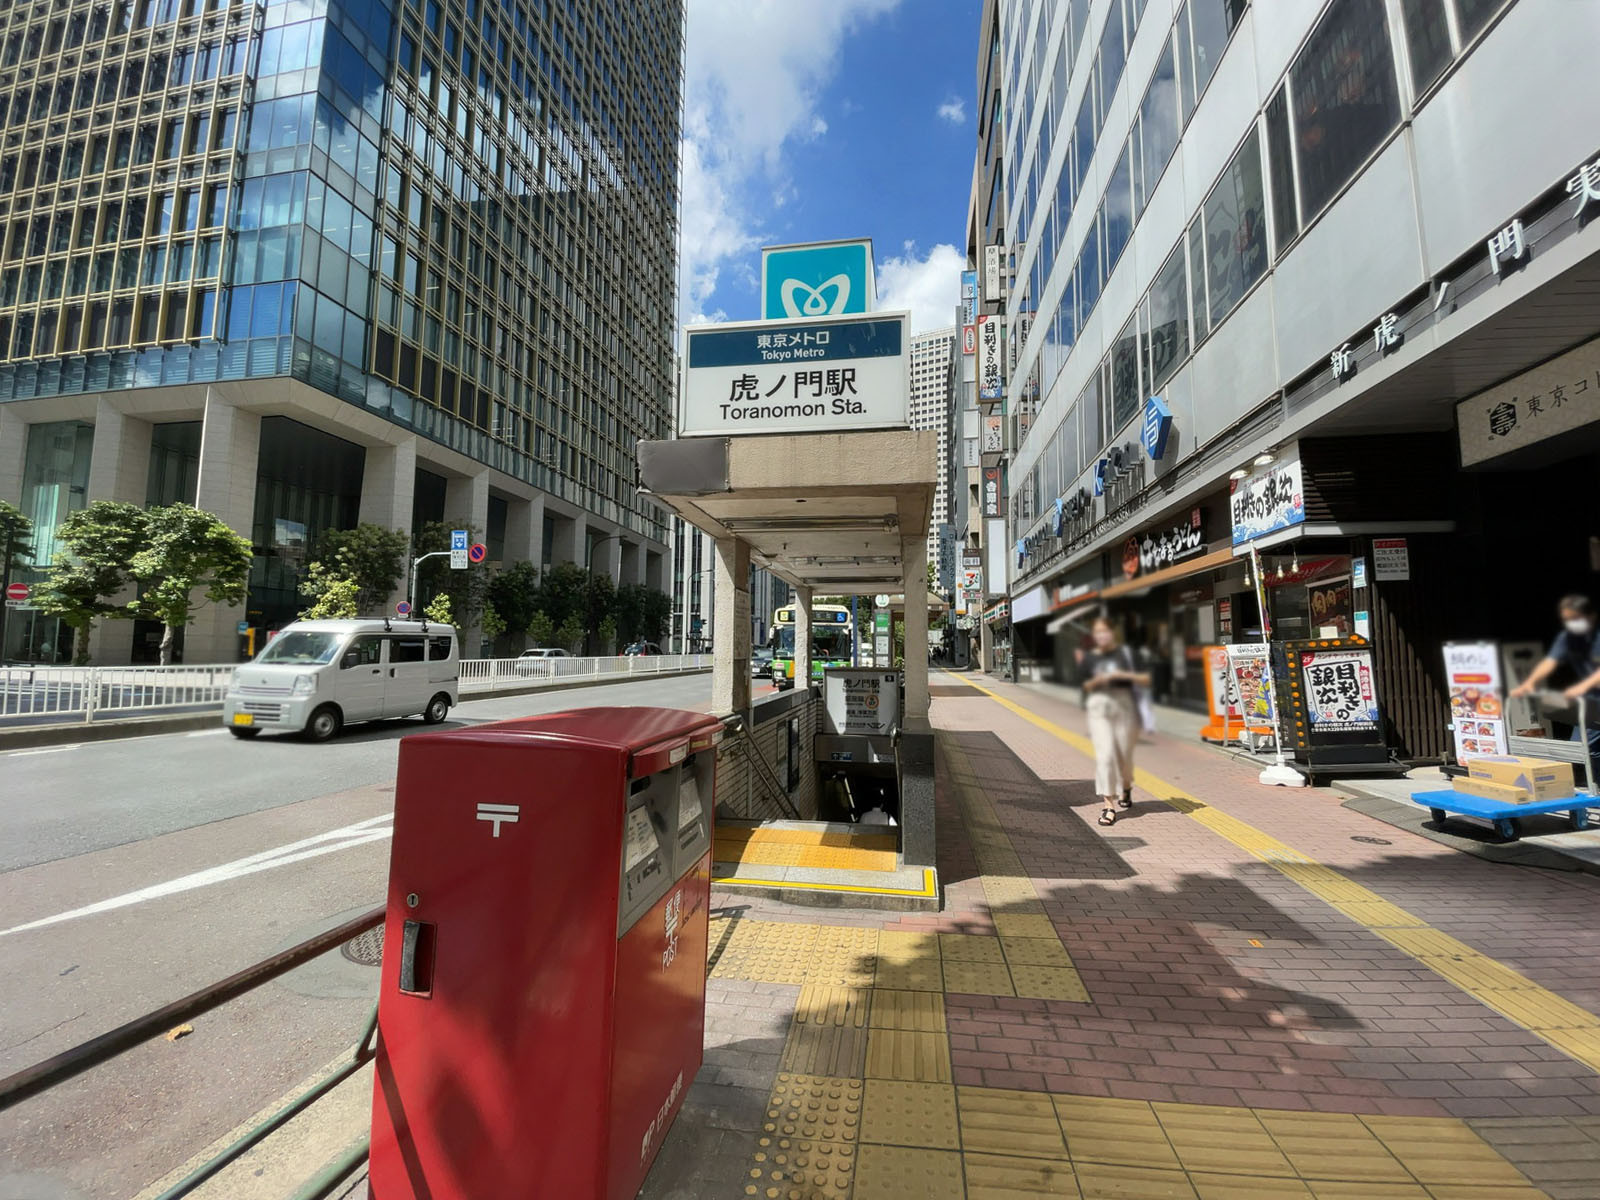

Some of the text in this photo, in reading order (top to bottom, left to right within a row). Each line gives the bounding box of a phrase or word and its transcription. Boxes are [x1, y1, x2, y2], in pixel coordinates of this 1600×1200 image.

[757, 332, 829, 349] 東京メトロ
[761, 347, 825, 362] Tokyo Metro
[729, 368, 857, 402] 虎ノ門駅
[720, 398, 867, 420] Toranomon Sta.
[1310, 666, 1338, 704] 銀次
[1336, 663, 1360, 720] 目利きの
